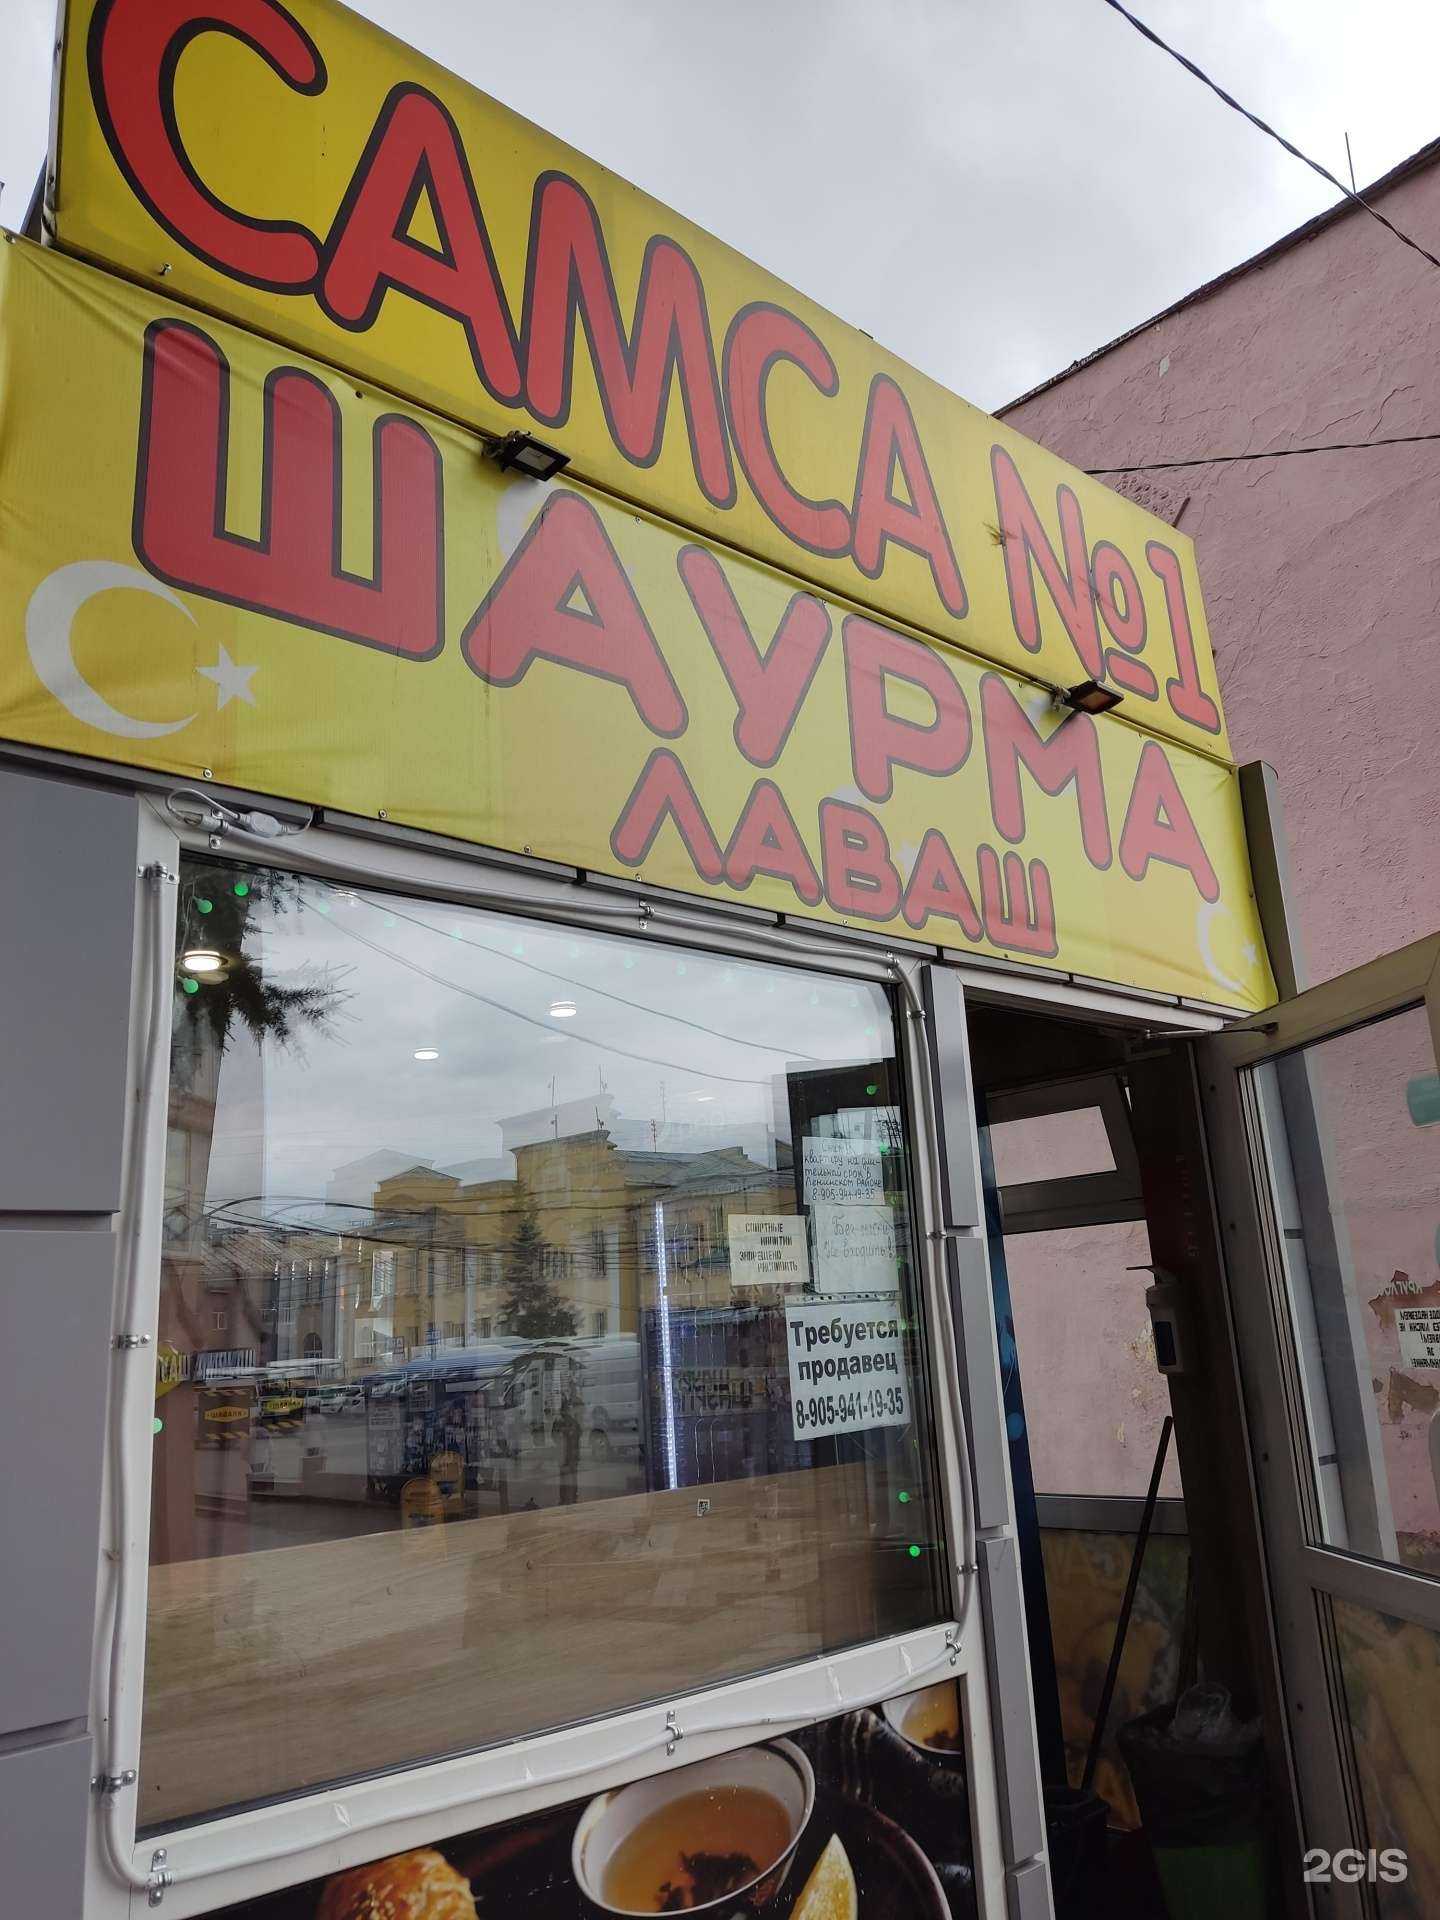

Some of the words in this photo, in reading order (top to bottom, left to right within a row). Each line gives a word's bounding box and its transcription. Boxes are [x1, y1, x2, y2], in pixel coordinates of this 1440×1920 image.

[87, 0, 968, 620] САМСА
[132, 317, 1221, 904] ШАУРМА
[609, 747, 1058, 958] ЛАВАШ
[789, 1317, 899, 1352] Требуется
[797, 1352, 899, 1386] продавец
[795, 1386, 904, 1430] 8-905-941-19-35
